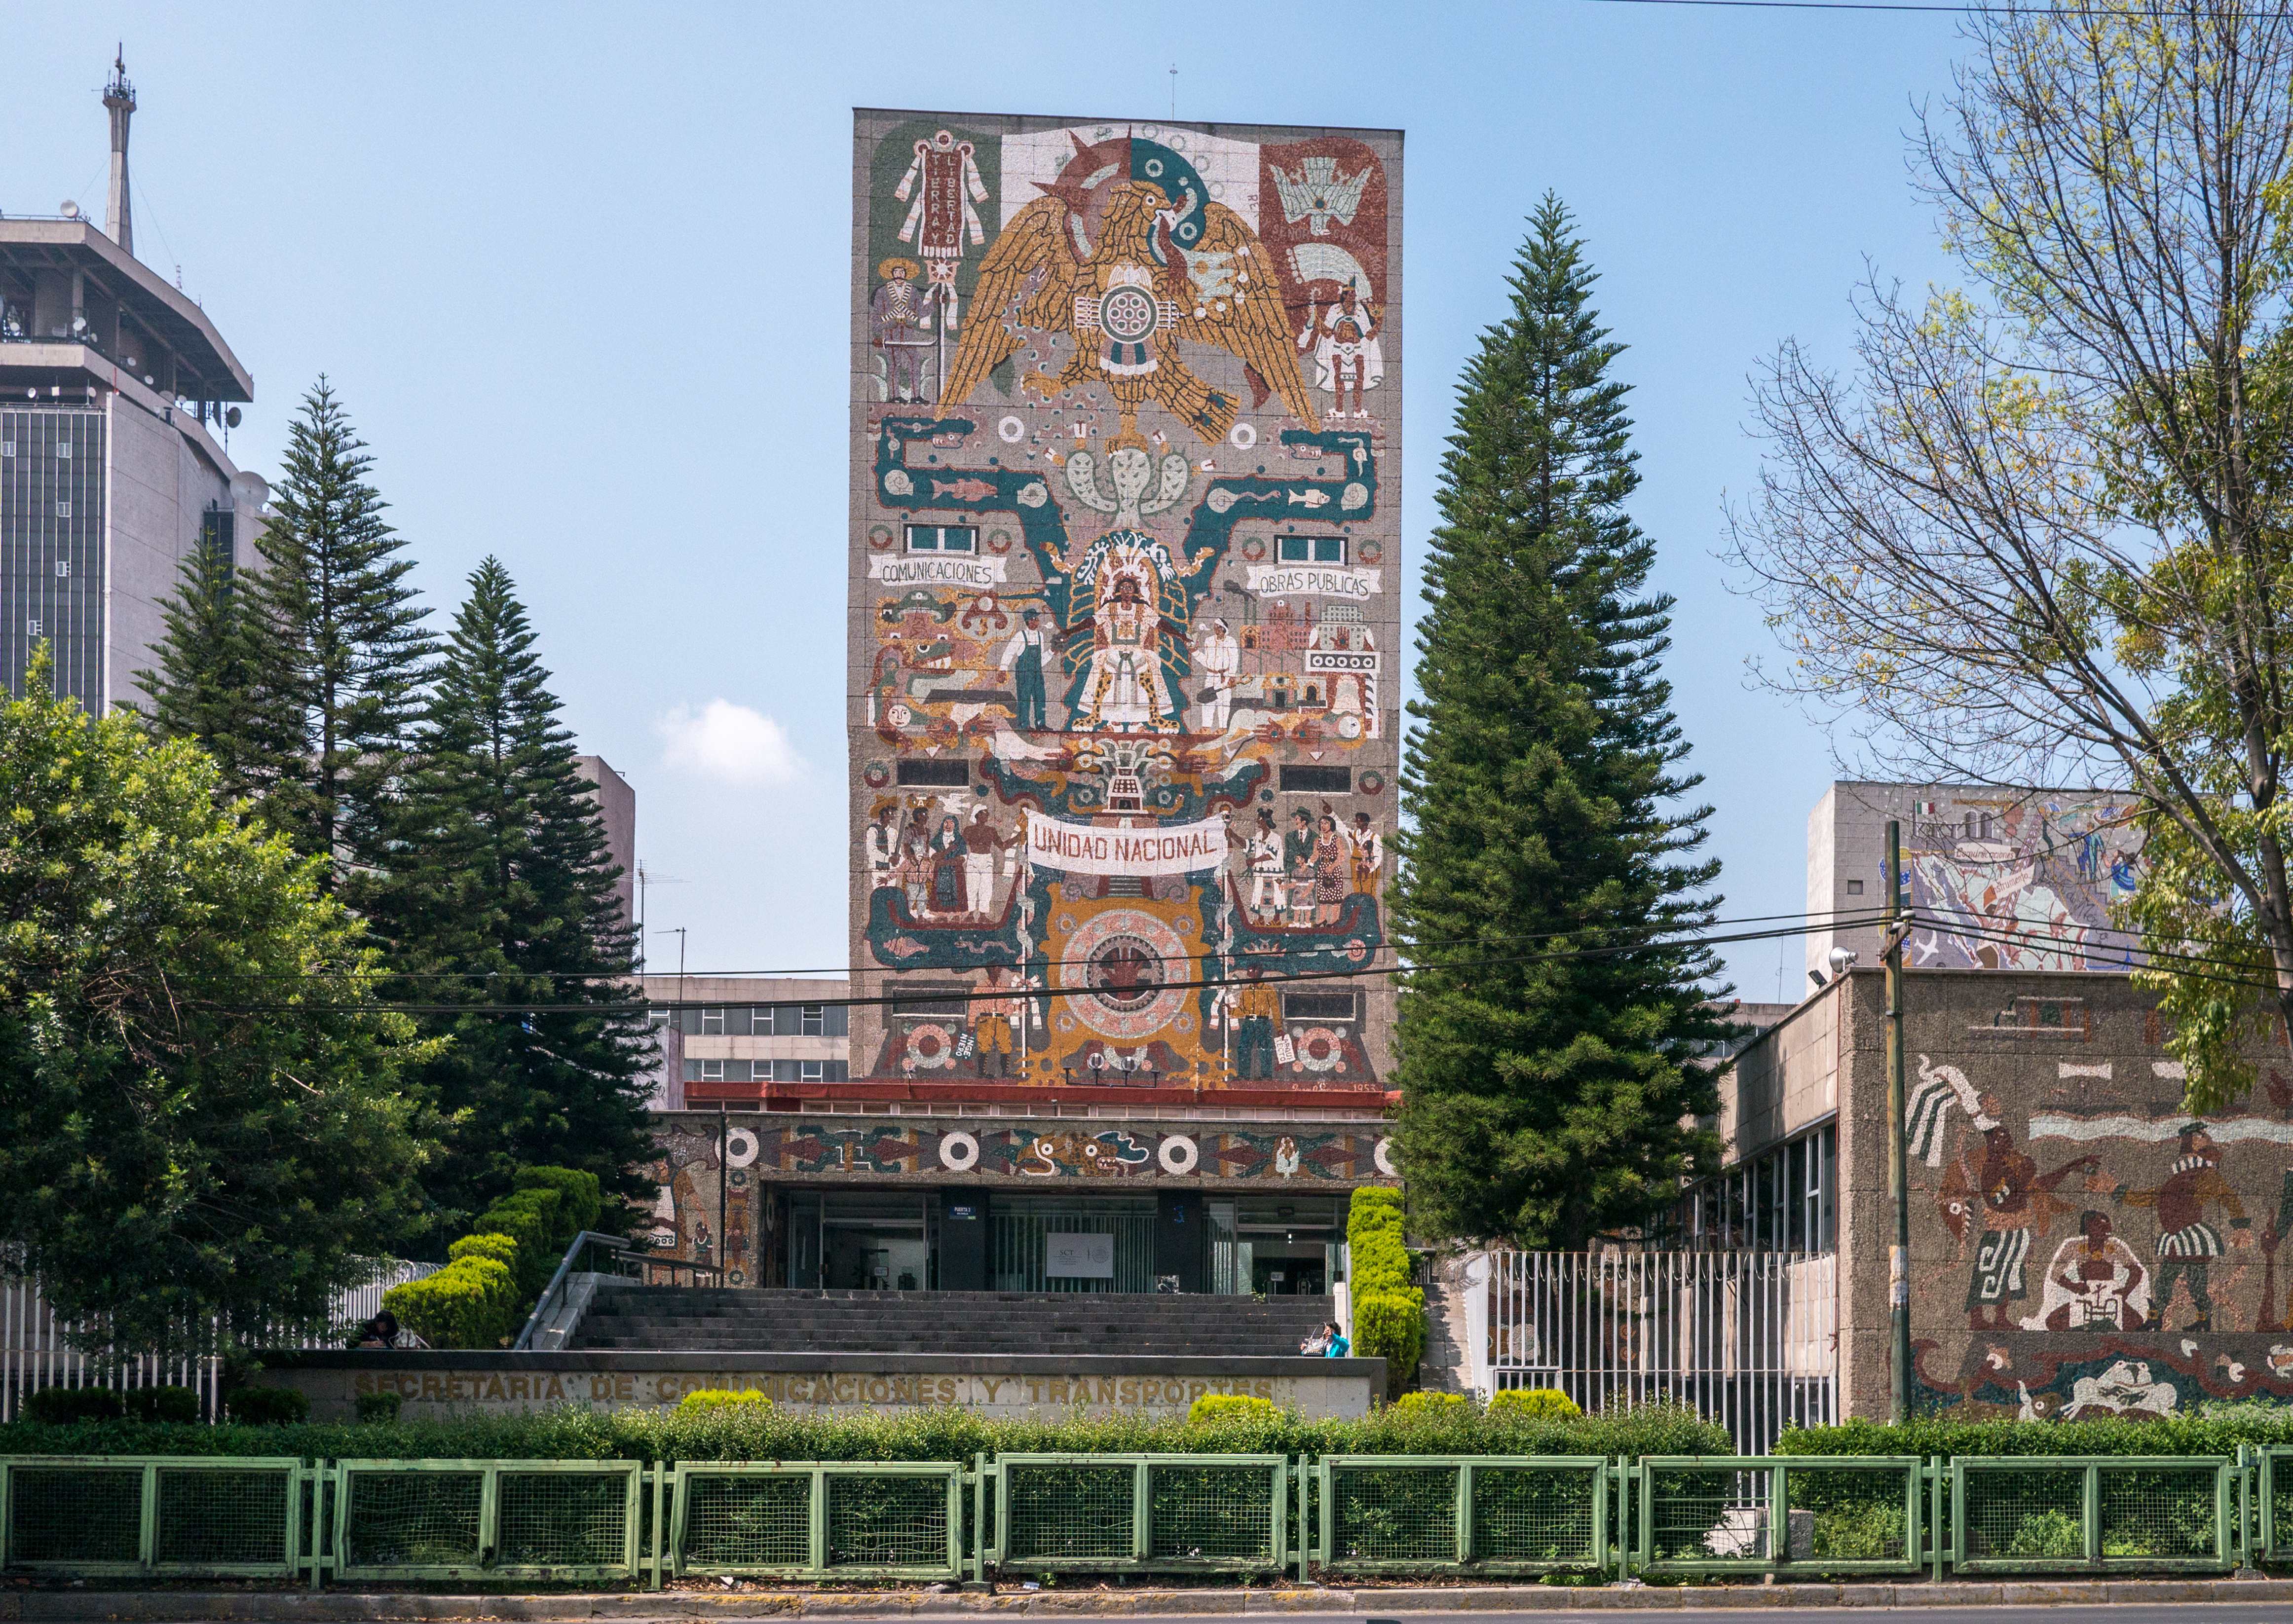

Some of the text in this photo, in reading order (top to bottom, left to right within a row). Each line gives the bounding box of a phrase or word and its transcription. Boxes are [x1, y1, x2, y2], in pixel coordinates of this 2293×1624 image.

[931, 155, 940, 227] TIERRA
[947, 155, 956, 244] LIBERTAD
[882, 561, 992, 585] COMUNICACIONES
[1260, 572, 1369, 597] OBRAS PUBLICAS
[1034, 823, 1218, 862] UNIDAD NACIONAL
[955, 1033, 968, 1057] NIERO
[1276, 1037, 1286, 1062] TECTO
[1353, 1084, 1376, 1092] 1953
[354, 1373, 565, 1400] SECRETARIA
[591, 1376, 633, 1401] DE
[982, 1380, 1002, 1403] Y
